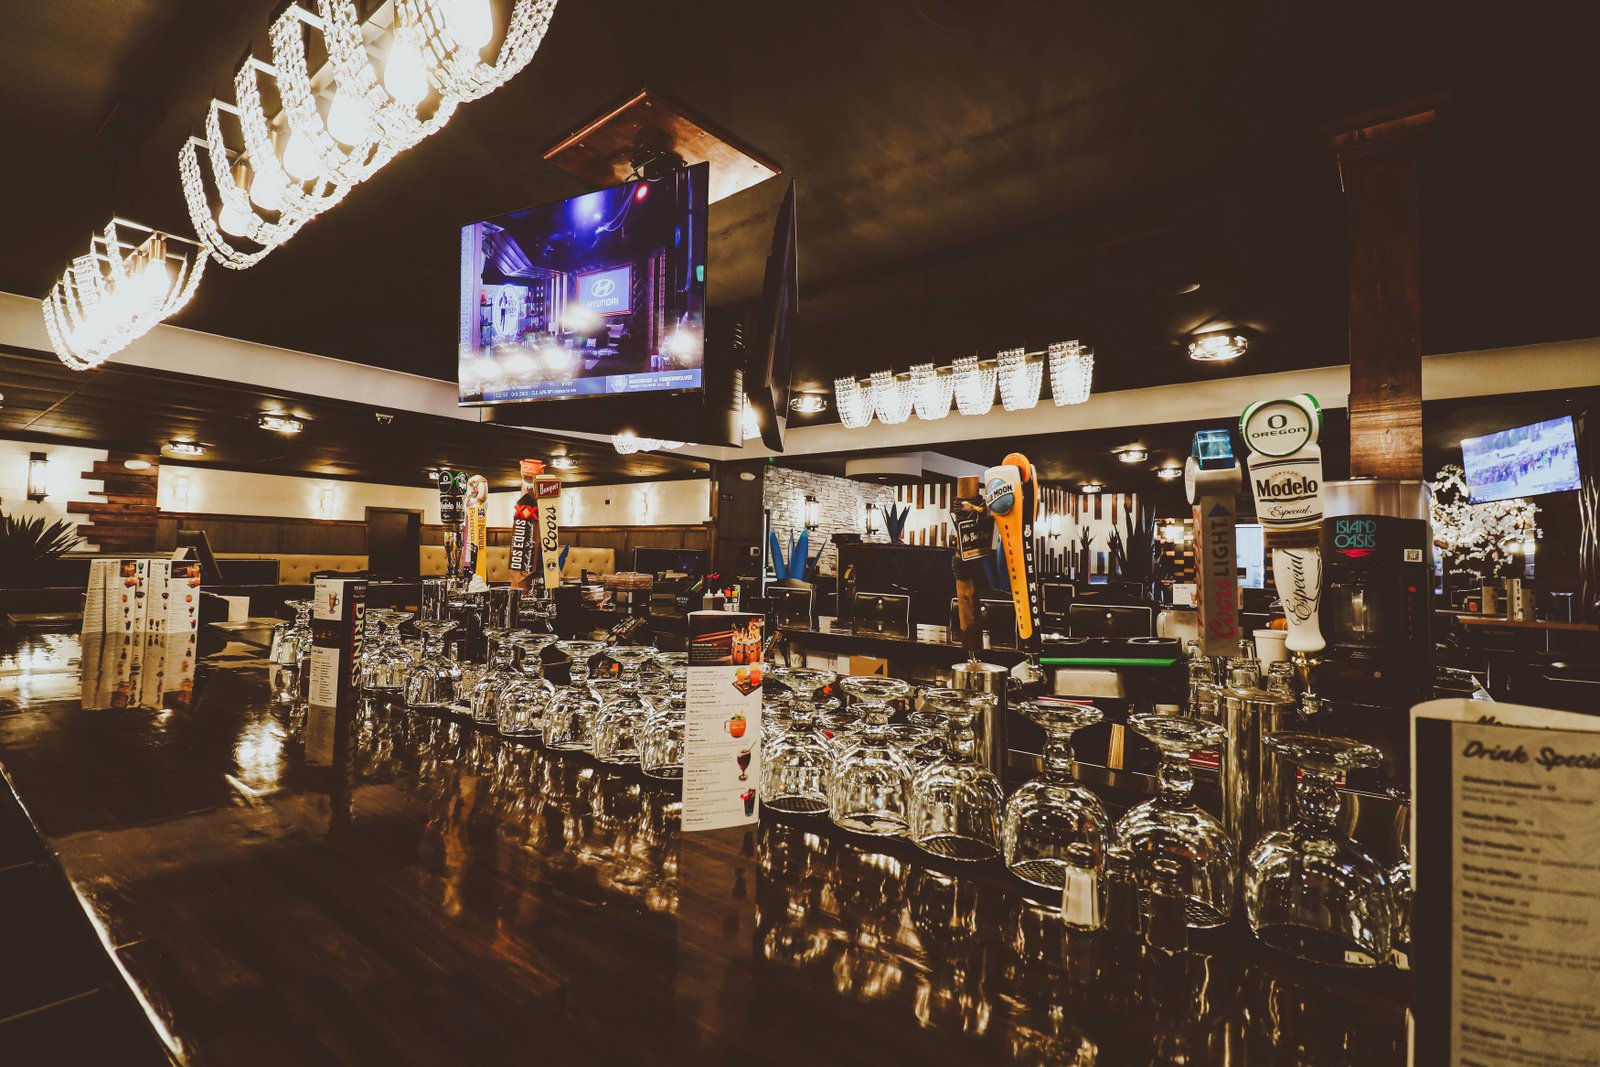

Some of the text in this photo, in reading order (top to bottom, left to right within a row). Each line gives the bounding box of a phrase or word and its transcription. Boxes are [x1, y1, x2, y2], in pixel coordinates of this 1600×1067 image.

[587, 297, 619, 308] HYUNDAI
[1251, 426, 1307, 439] OREGON
[993, 484, 1013, 499] MOON
[1256, 476, 1318, 498] Modelo
[1268, 505, 1310, 519] Especial
[542, 505, 558, 553] Coors
[1336, 520, 1377, 534] ISLAND
[511, 519, 526, 569] DOS EQUIS
[1334, 533, 1376, 548] OASIS
[1004, 524, 1024, 630] BELGIAN WHITE
[1024, 524, 1040, 627] BLUE MOON
[1209, 518, 1235, 640] Coors LIGHT
[1285, 550, 1313, 626] Especial
[351, 602, 366, 688] DRINKS
[1463, 740, 1529, 764] Drink
